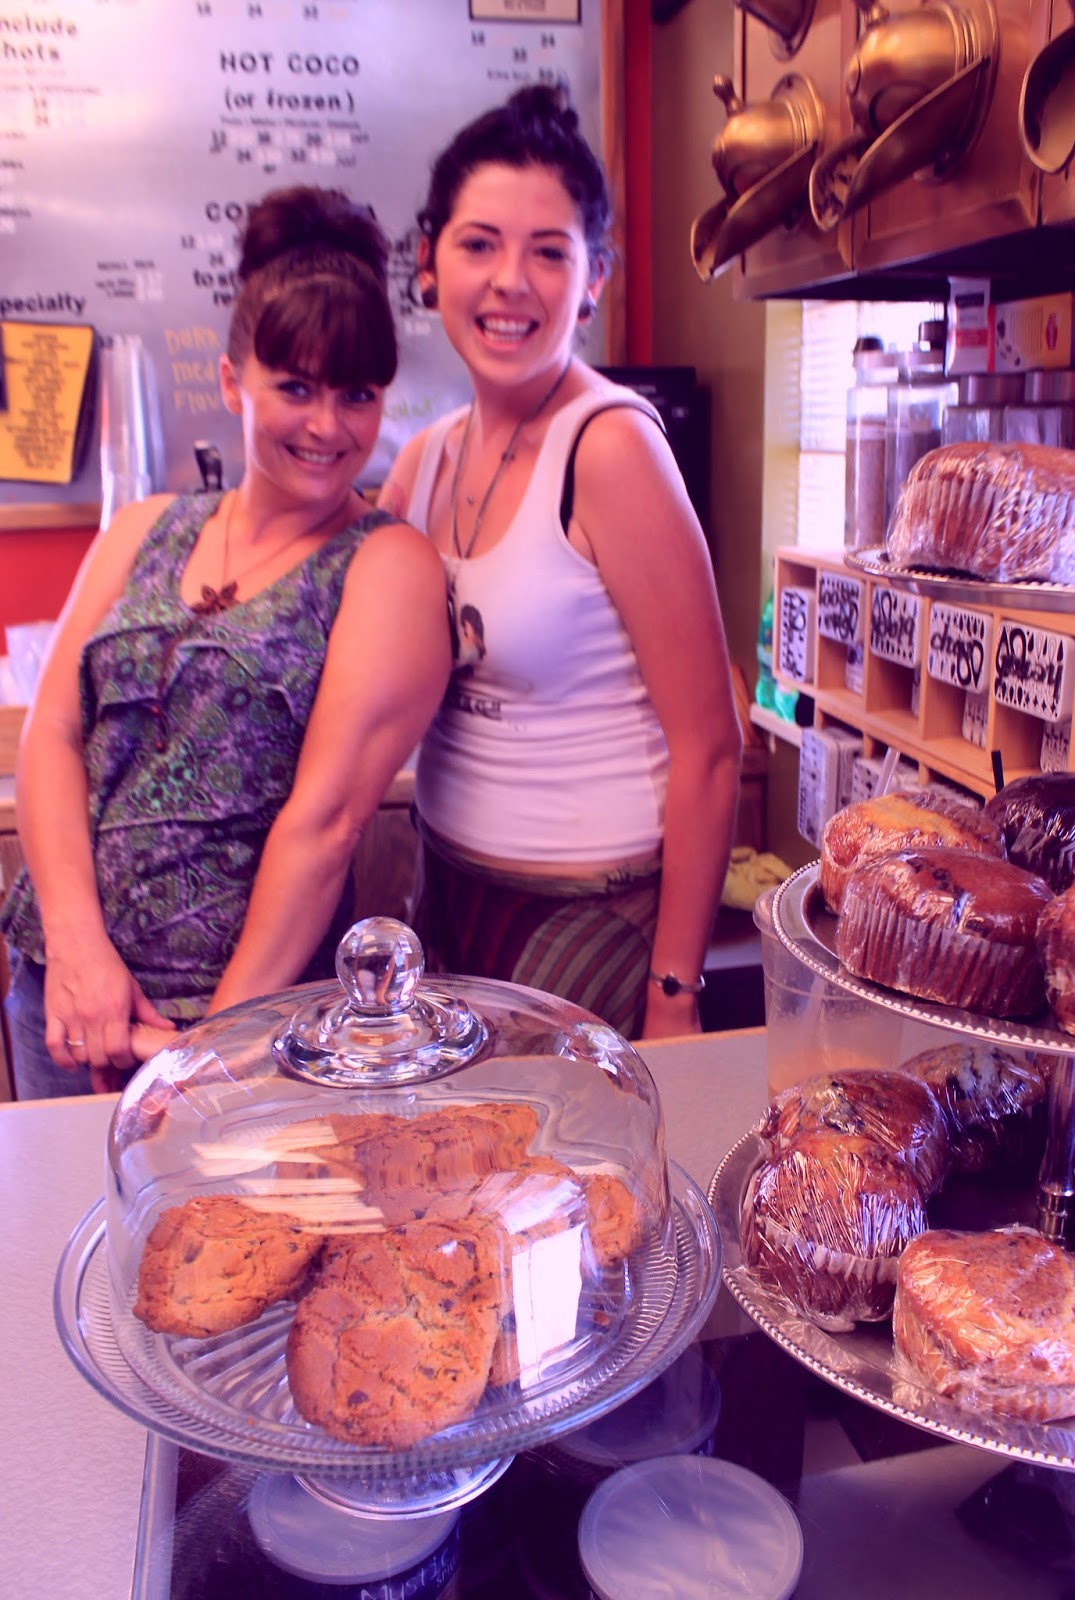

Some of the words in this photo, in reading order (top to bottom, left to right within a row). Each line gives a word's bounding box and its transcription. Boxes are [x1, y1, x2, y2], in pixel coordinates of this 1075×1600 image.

[219, 52, 271, 73] HOT
[287, 54, 360, 76] COCO
[224, 86, 254, 112] (or
[266, 87, 355, 114] frozen)
[0, 292, 86, 318] pecialty
